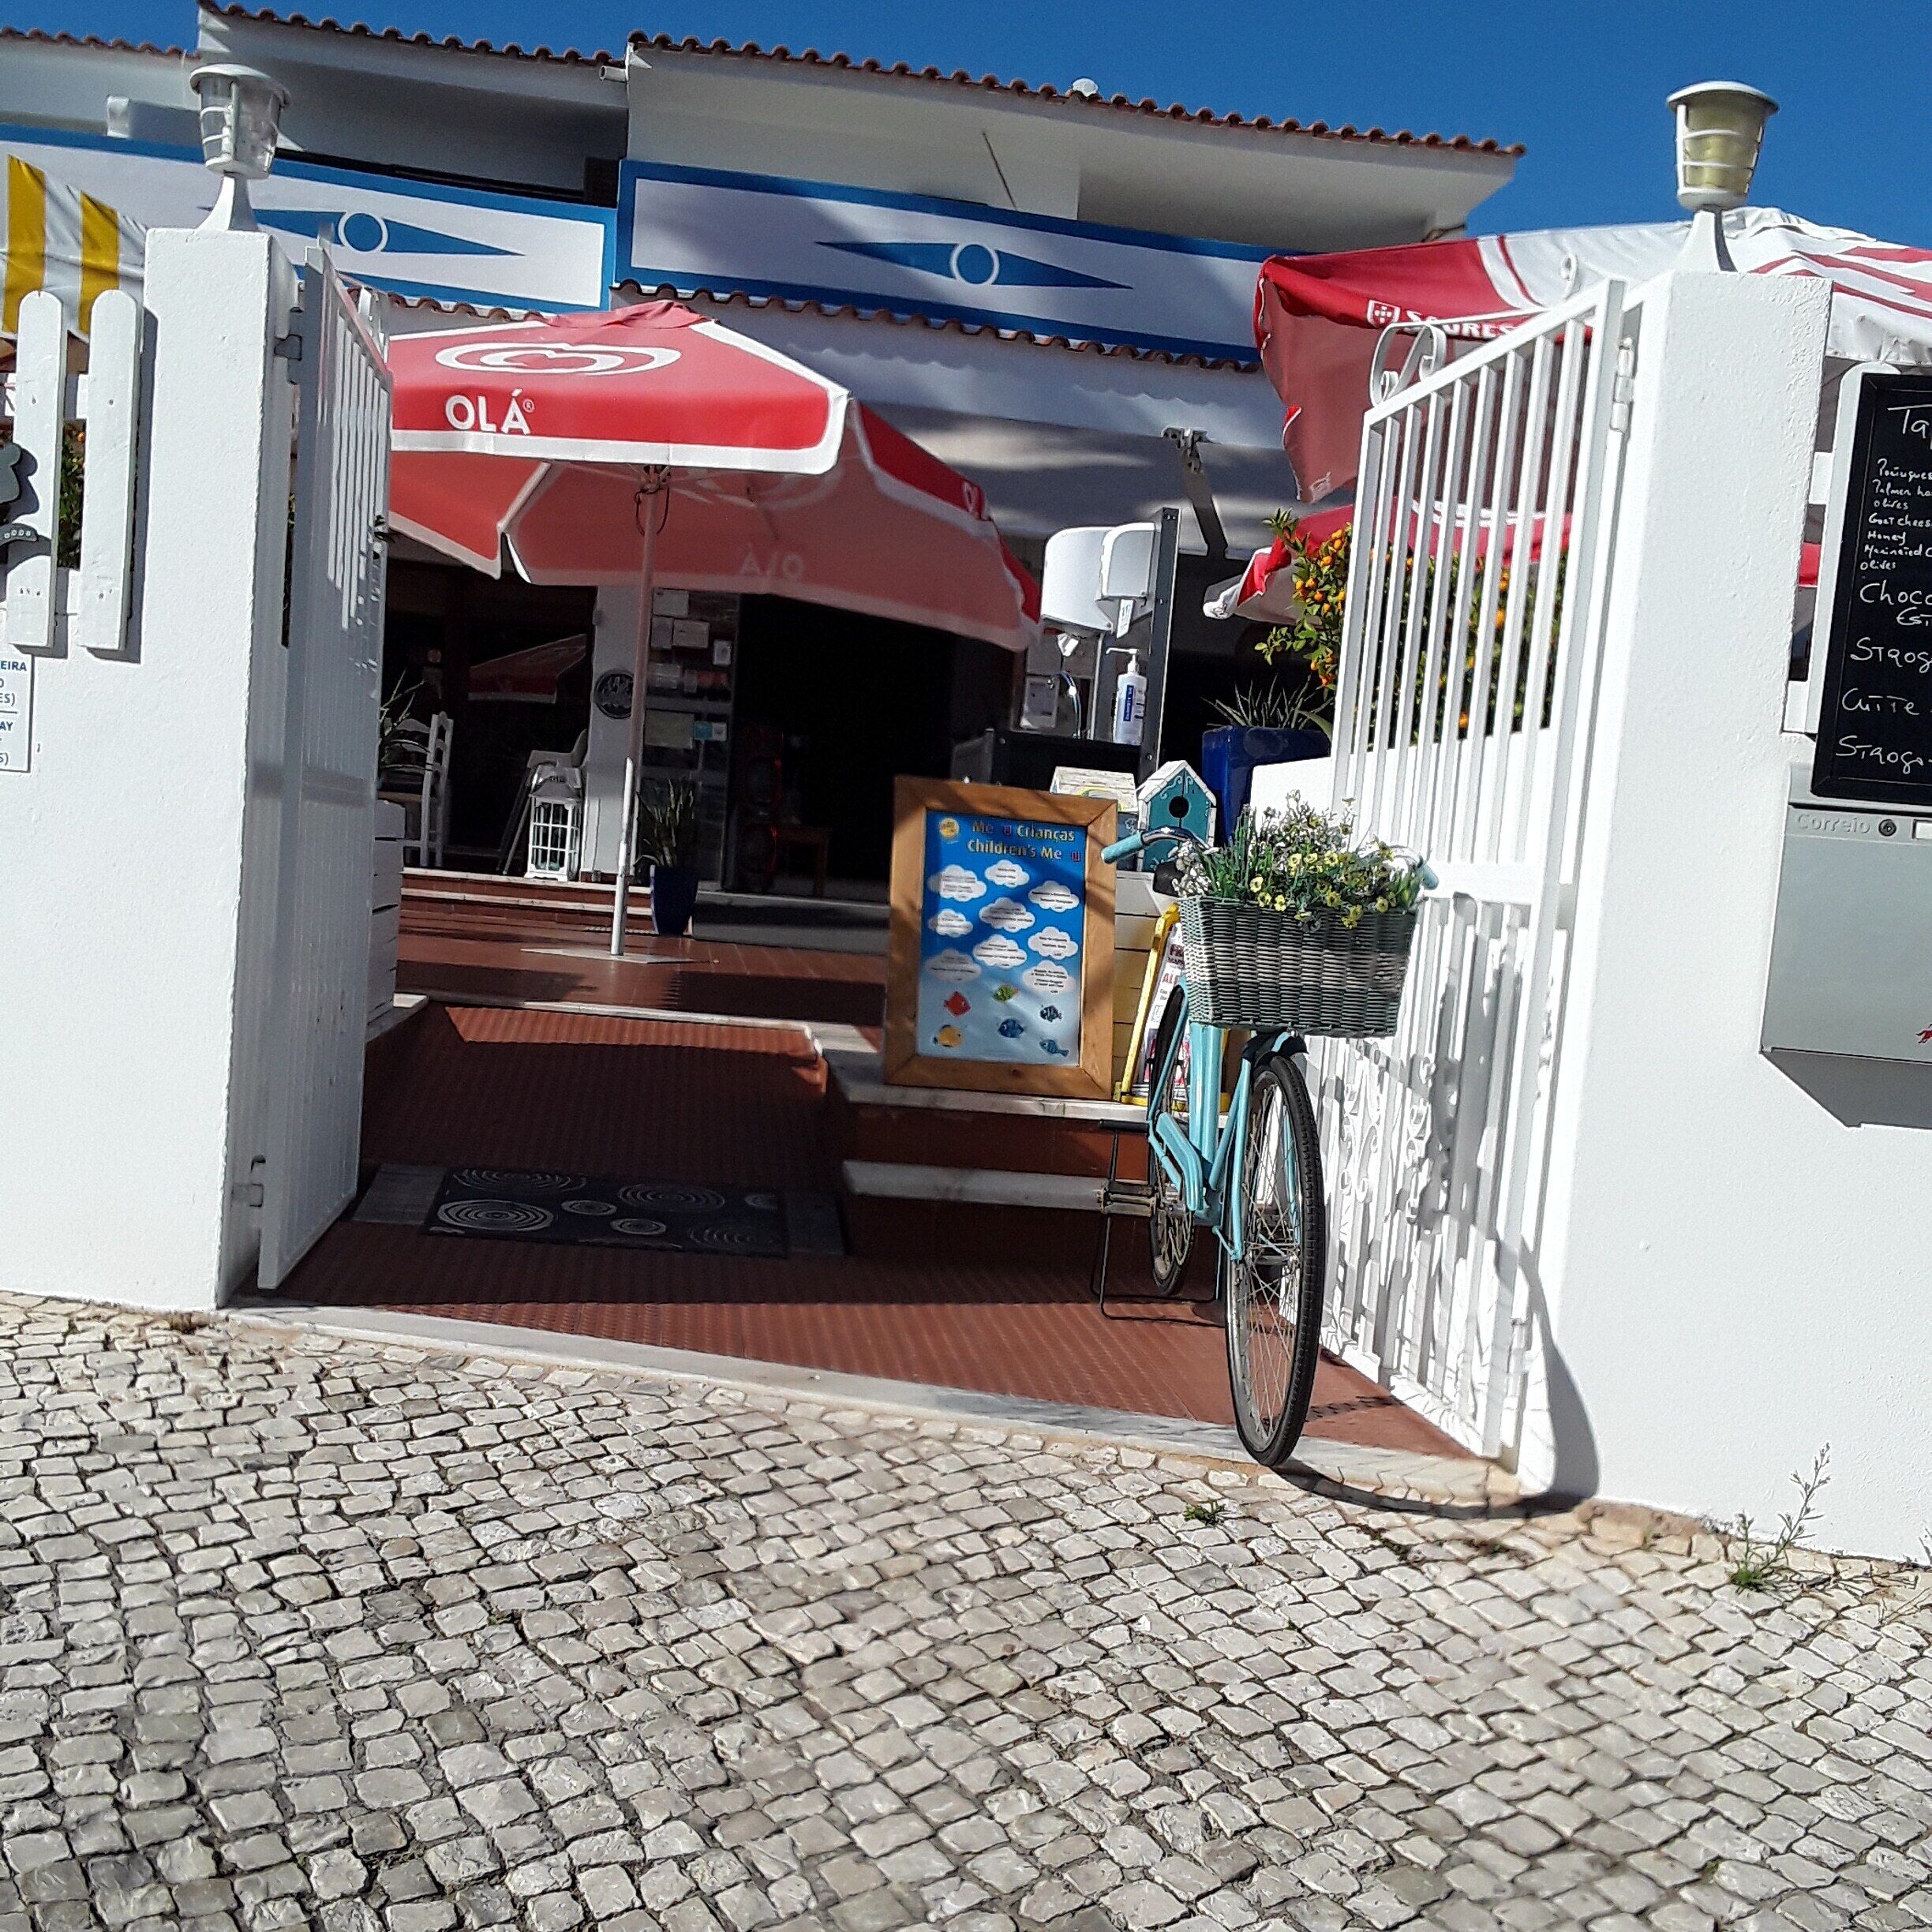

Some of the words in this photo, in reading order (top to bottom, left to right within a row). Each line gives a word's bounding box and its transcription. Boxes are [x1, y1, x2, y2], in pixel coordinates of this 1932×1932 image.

[1867, 530, 1906, 546] Honey
[1798, 814, 1870, 833] Correio
[1016, 824, 1075, 843] Crianças
[967, 838, 1036, 858] Children's
